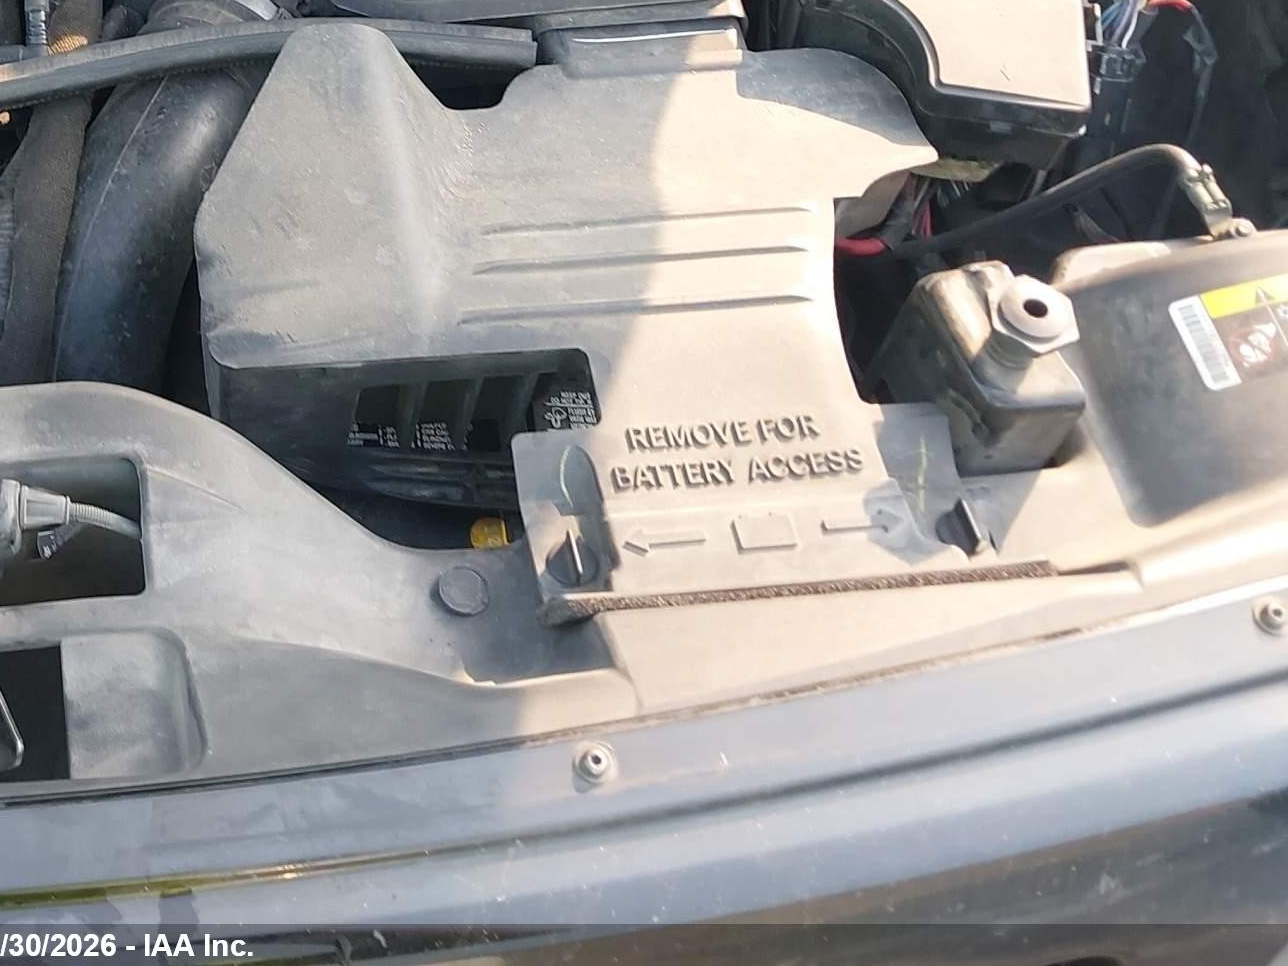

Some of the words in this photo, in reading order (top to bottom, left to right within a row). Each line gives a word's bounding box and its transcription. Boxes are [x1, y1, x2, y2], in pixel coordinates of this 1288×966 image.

[625, 417, 753, 452] REMOVE
[755, 413, 821, 442] FOR
[610, 456, 736, 492] BATTERY
[748, 448, 864, 483] ACCESS
